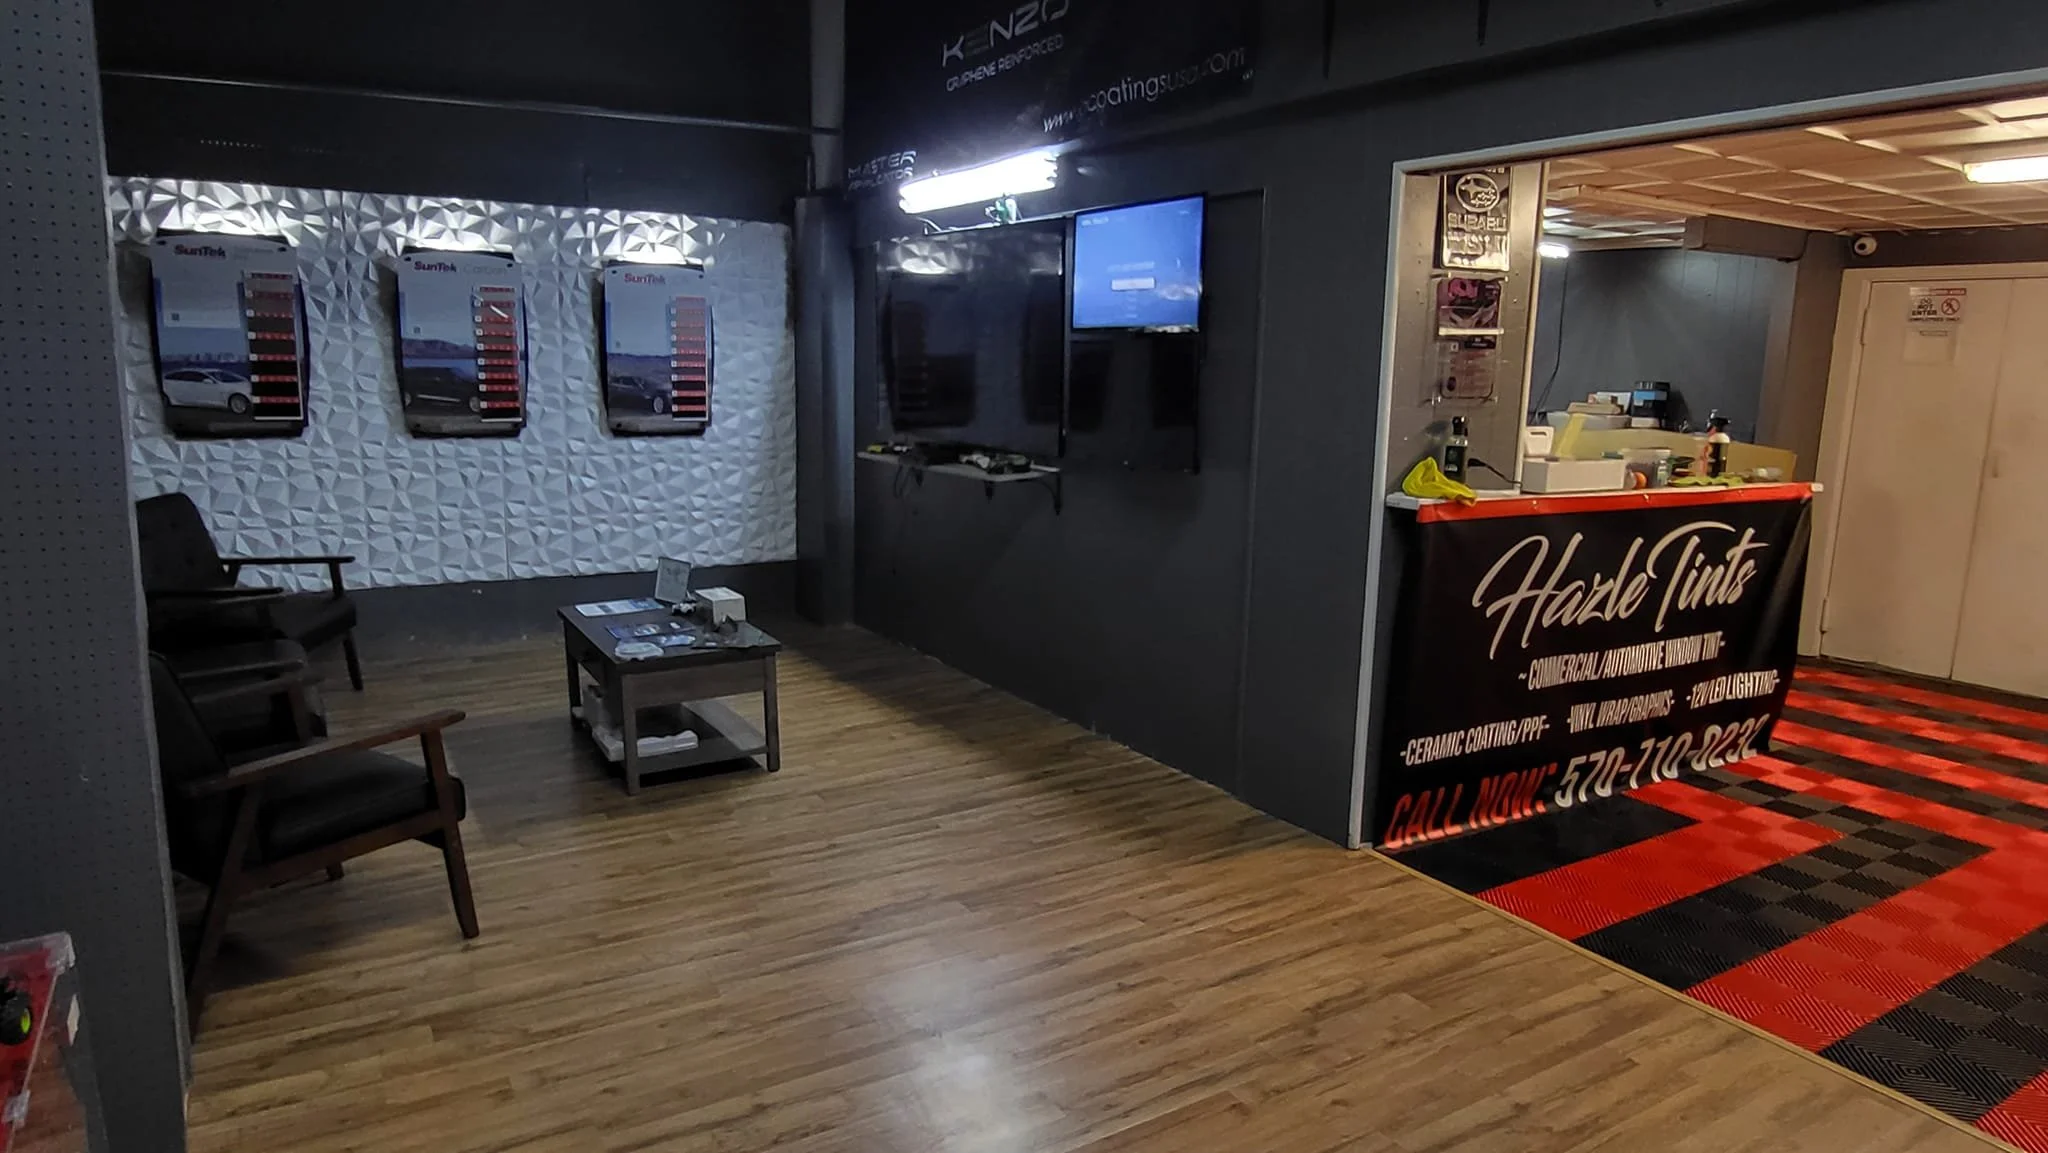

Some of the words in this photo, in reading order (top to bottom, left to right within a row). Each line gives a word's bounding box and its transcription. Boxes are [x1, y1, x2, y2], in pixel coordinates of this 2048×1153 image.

[847, 150, 917, 179] MASTER
[1447, 212, 1507, 231] SUBARU
[173, 244, 227, 259] SunTek
[413, 260, 457, 274] SunTek
[623, 271, 667, 286] SunTek
[1471, 531, 1651, 661] Hazle
[1646, 520, 1770, 633] Tints
[1528, 640, 1665, 691] COMMERCIAL/AUTOMOTIVE
[1664, 634, 1704, 668] WINDOW
[1384, 784, 1463, 849] CALL
